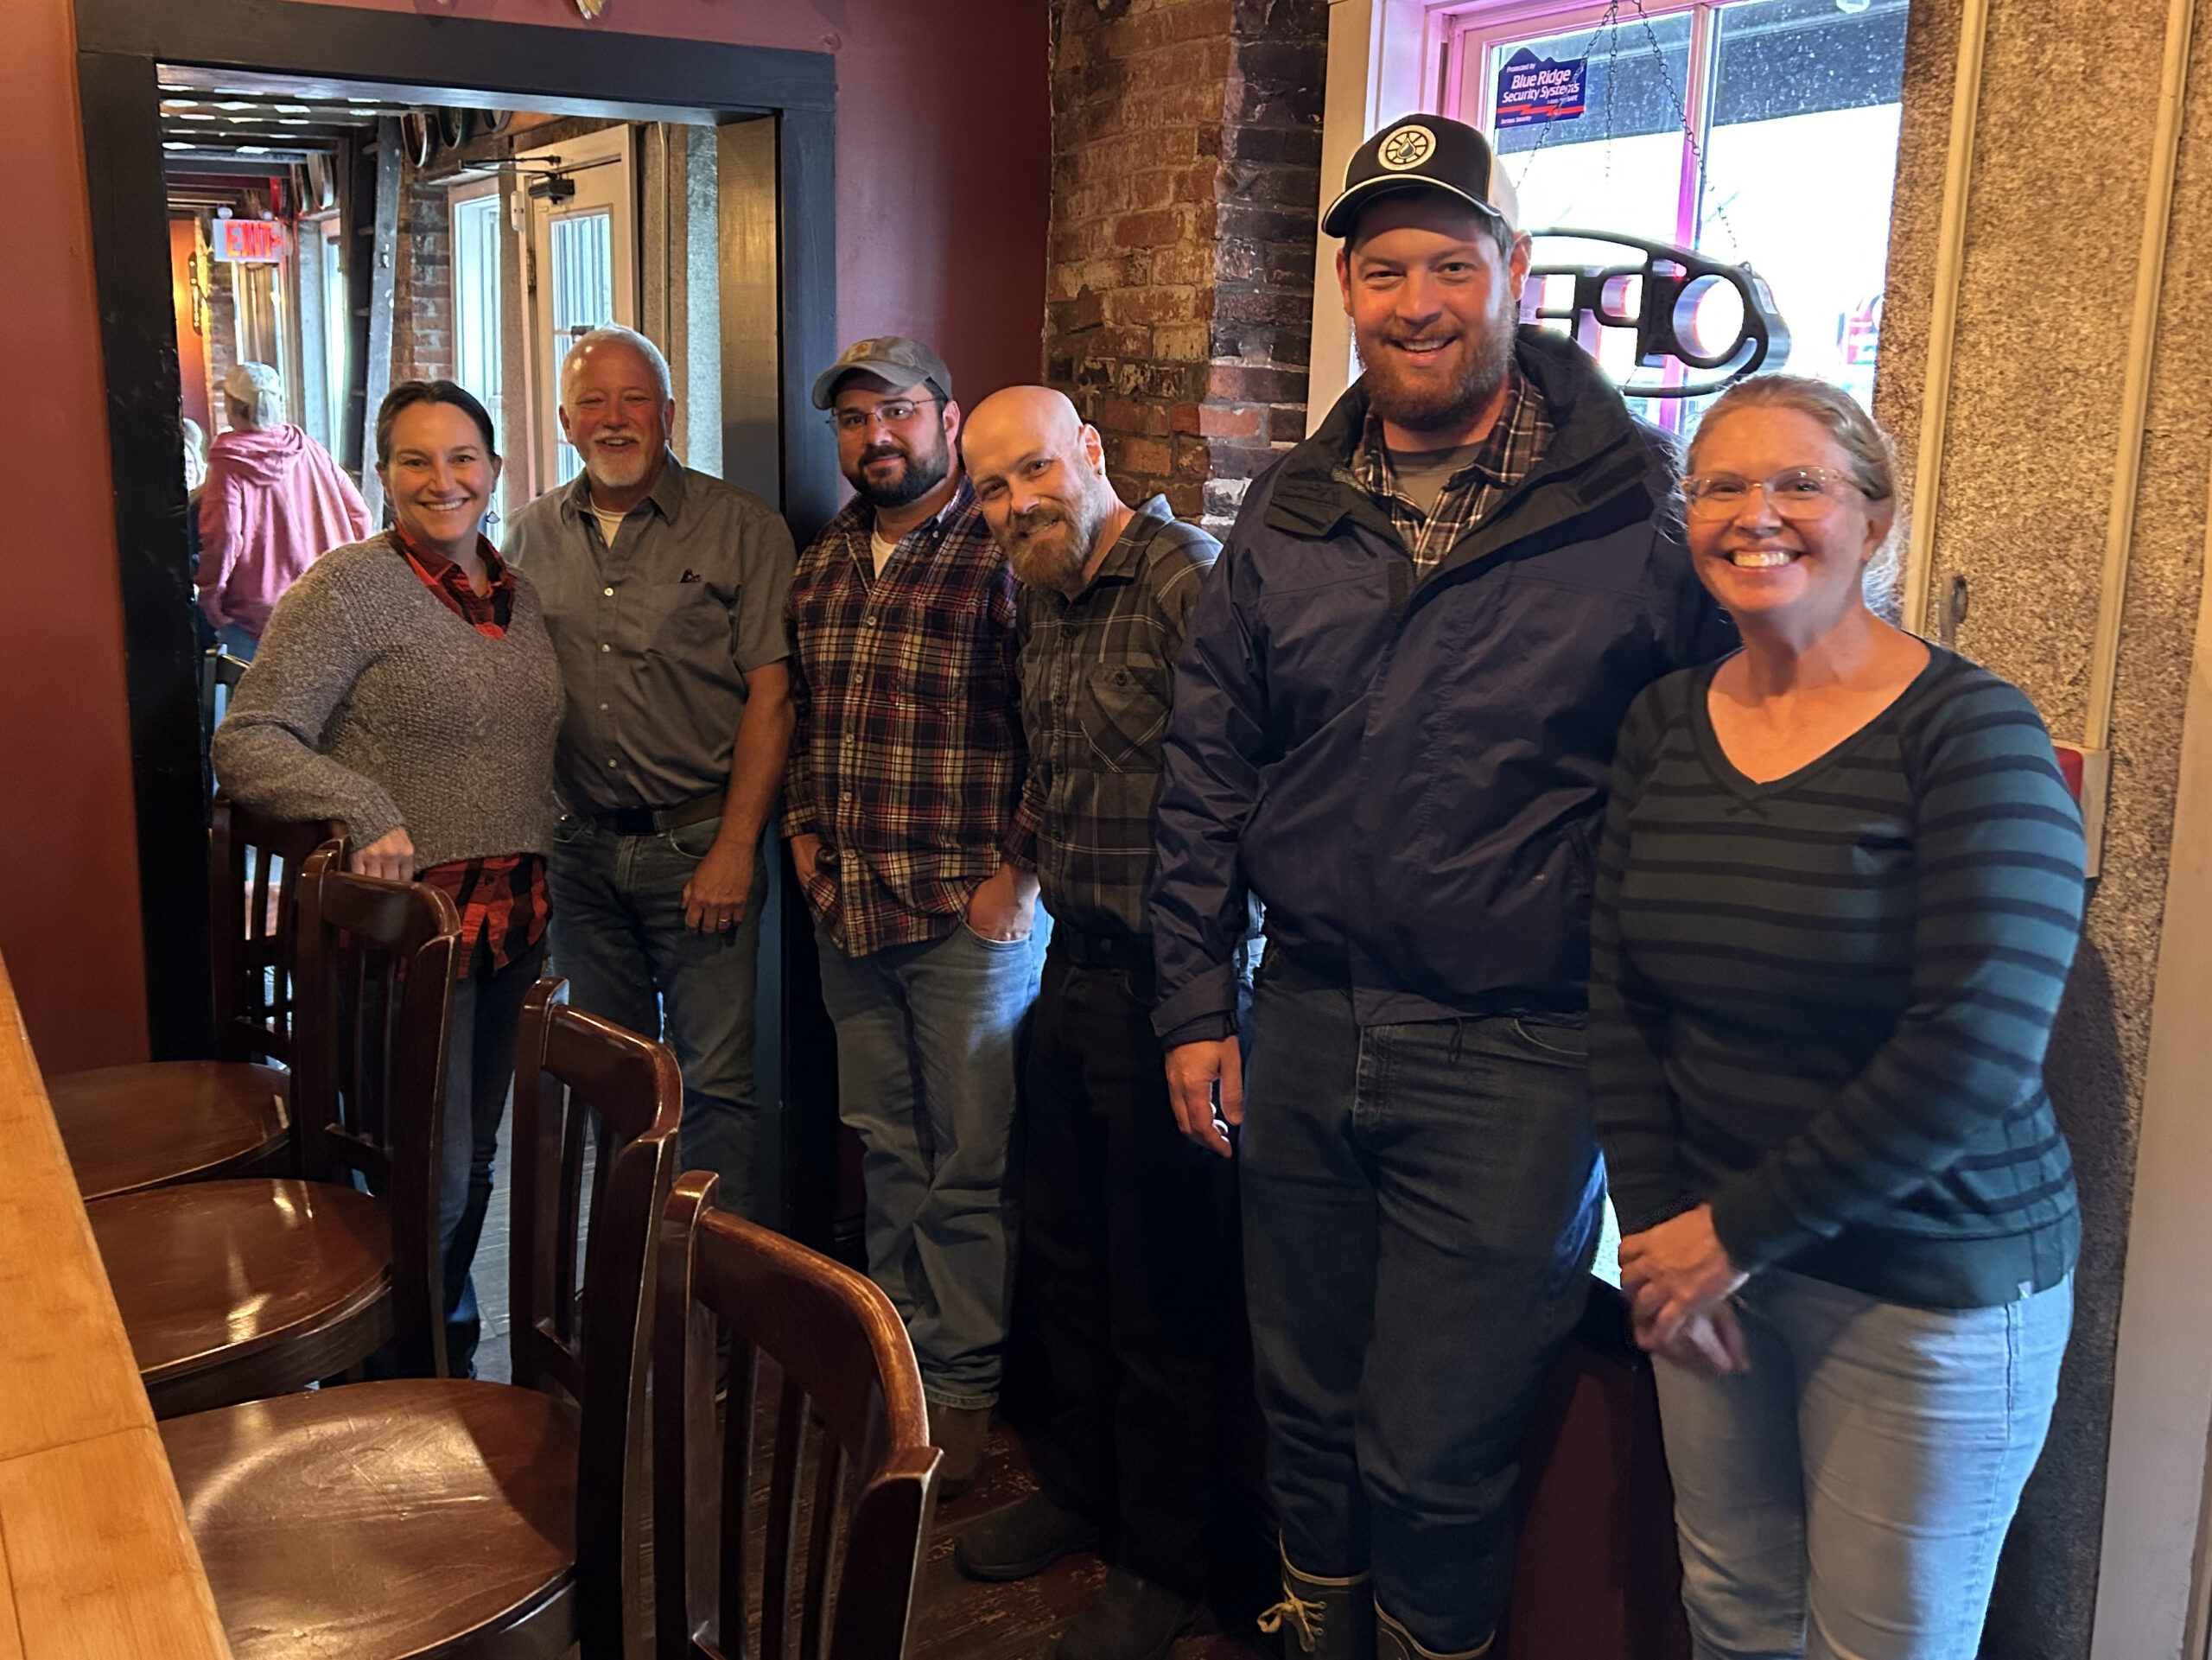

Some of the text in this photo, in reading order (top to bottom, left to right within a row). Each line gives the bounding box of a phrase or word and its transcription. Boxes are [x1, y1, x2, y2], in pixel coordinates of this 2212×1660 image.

[1510, 68, 1571, 89] Blue Ridge
[1502, 87, 1540, 104] Security
[225, 221, 273, 257] EXIT
